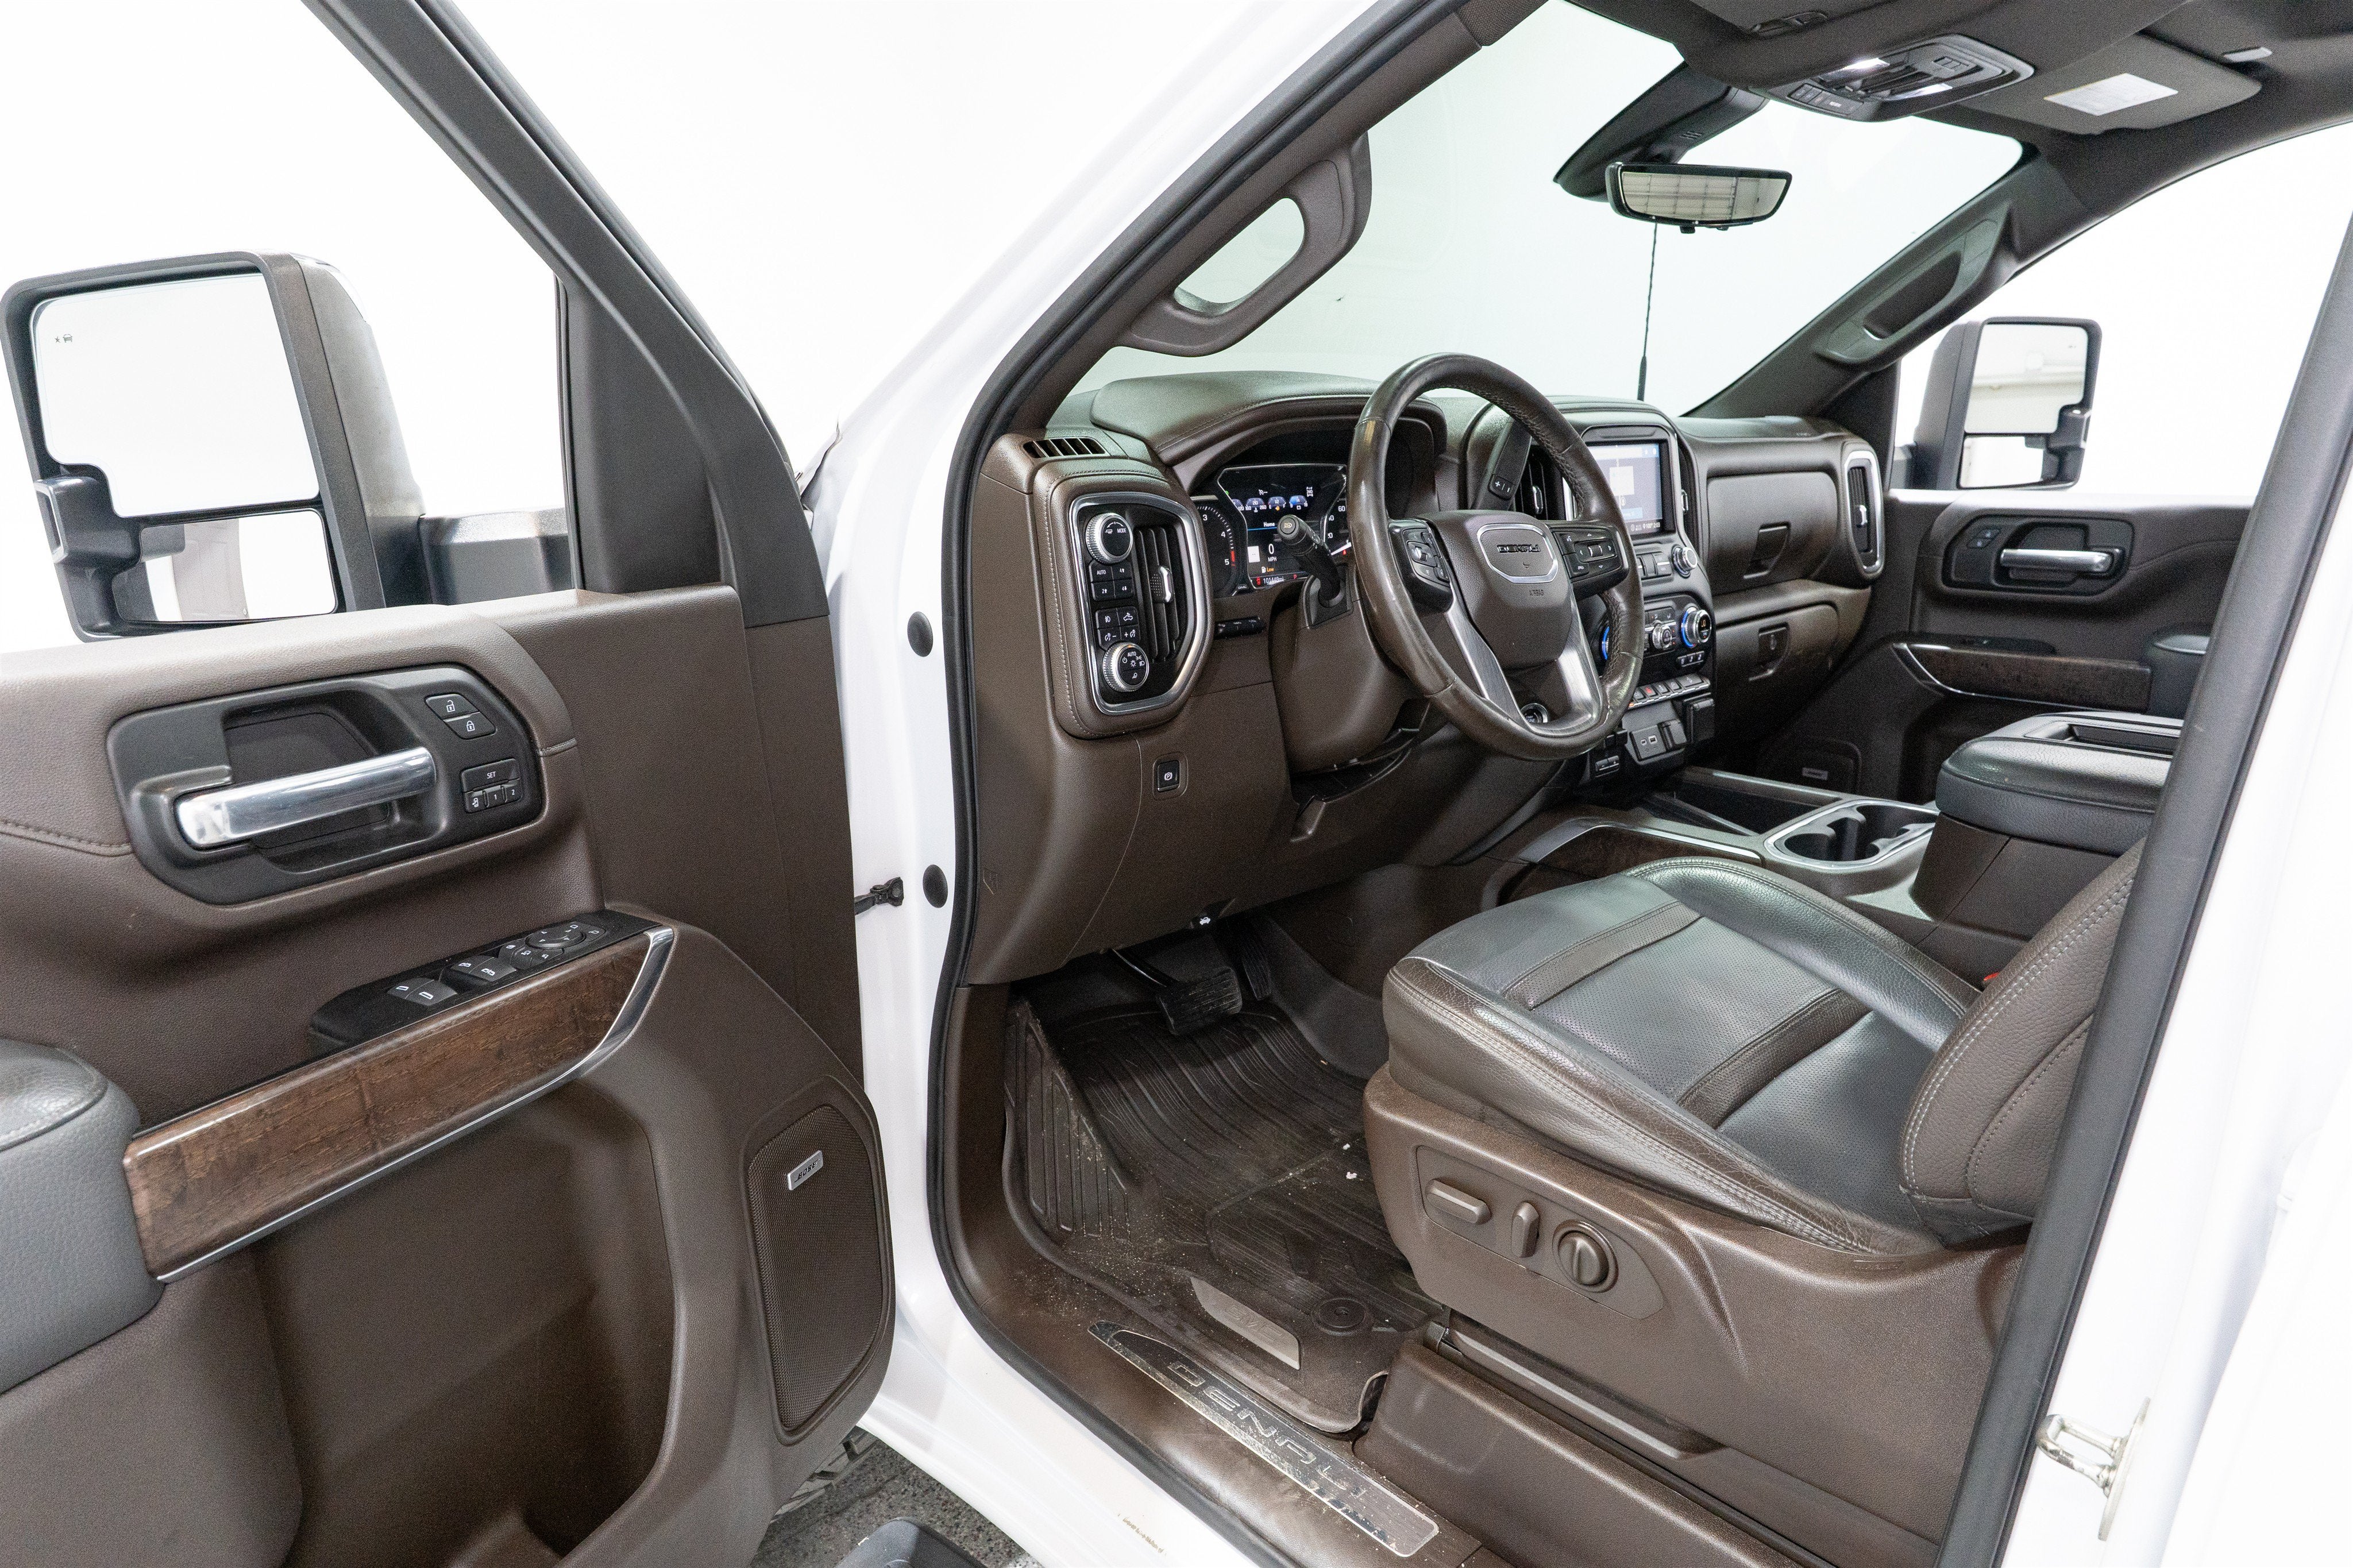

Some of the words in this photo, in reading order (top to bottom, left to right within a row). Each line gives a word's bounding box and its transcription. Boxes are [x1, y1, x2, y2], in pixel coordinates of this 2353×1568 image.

[1268, 543, 1274, 554] 0
[796, 1159, 819, 1181] BOSE
[1167, 1362, 1367, 1497] DENALI
